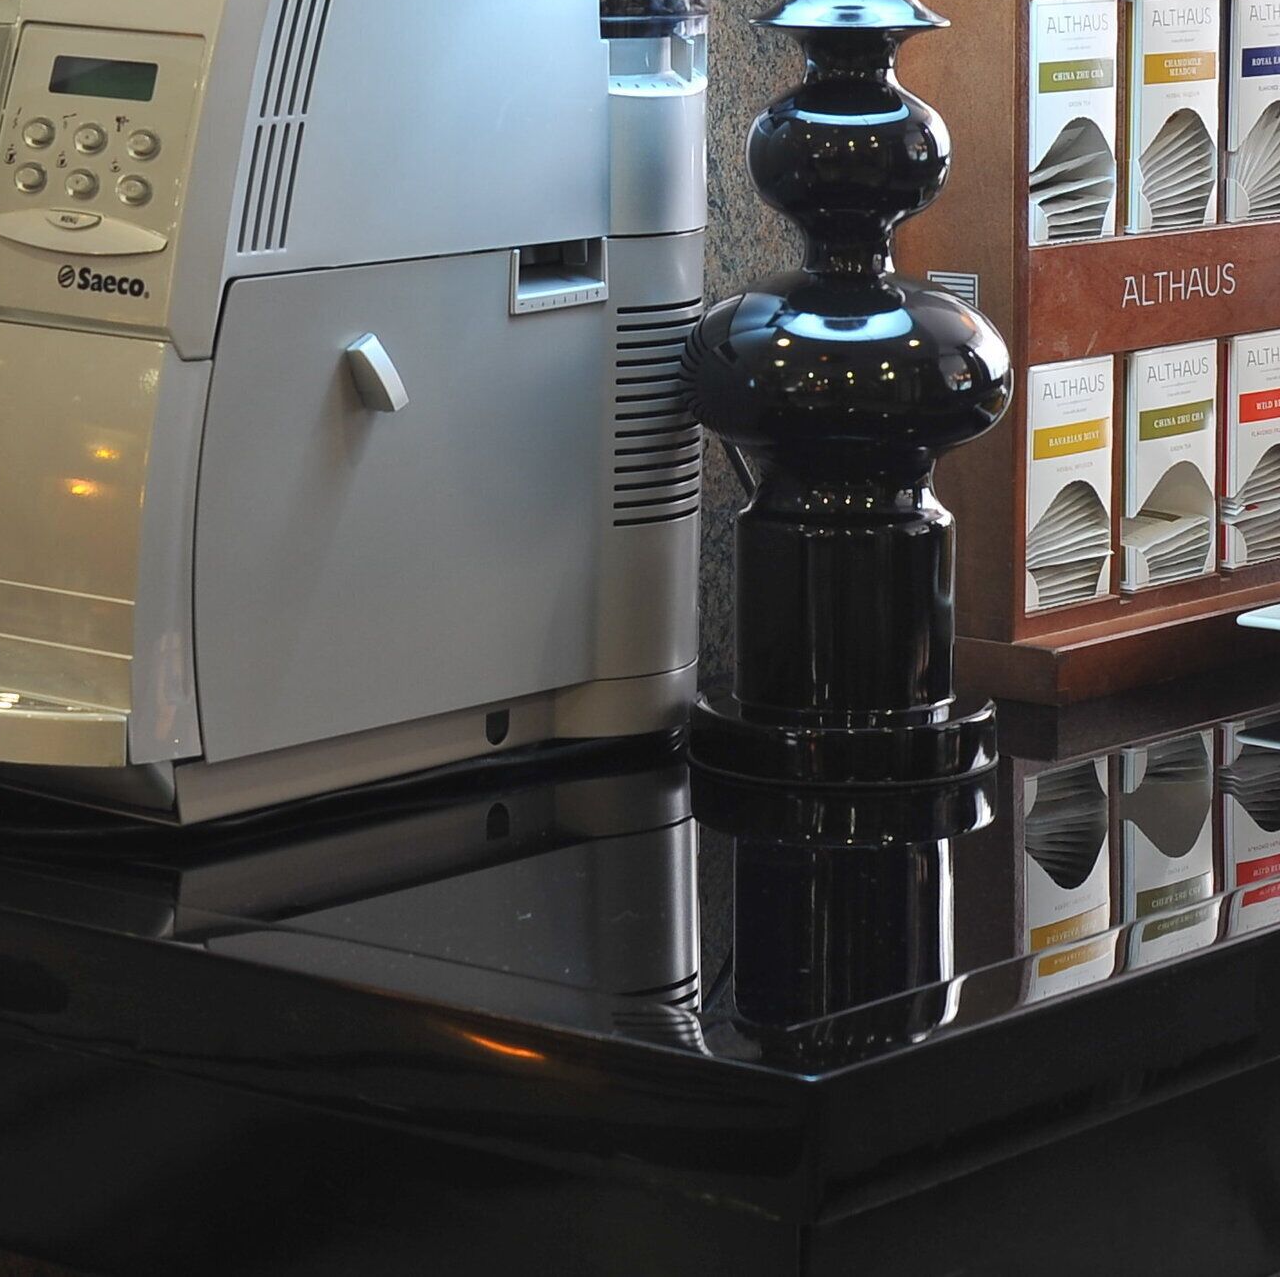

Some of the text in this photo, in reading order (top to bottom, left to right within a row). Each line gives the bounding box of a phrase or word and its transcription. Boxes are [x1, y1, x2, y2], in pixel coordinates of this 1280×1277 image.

[1046, 13, 1109, 34] ALTHAUS
[1152, 7, 1212, 27] ALTHAUS
[1252, 57, 1272, 66] ROYAL
[1052, 71, 1075, 81] CHINA
[77, 267, 145, 297] Saeco
[1121, 262, 1237, 309] ALTHAUS
[1147, 356, 1209, 383] ALTHAUS
[1042, 373, 1105, 400] ALTHAUS
[1256, 401, 1273, 410] WILD
[1153, 411, 1204, 428] CHINA ZHU CHA
[1049, 434, 1082, 447] BAVARIAN
